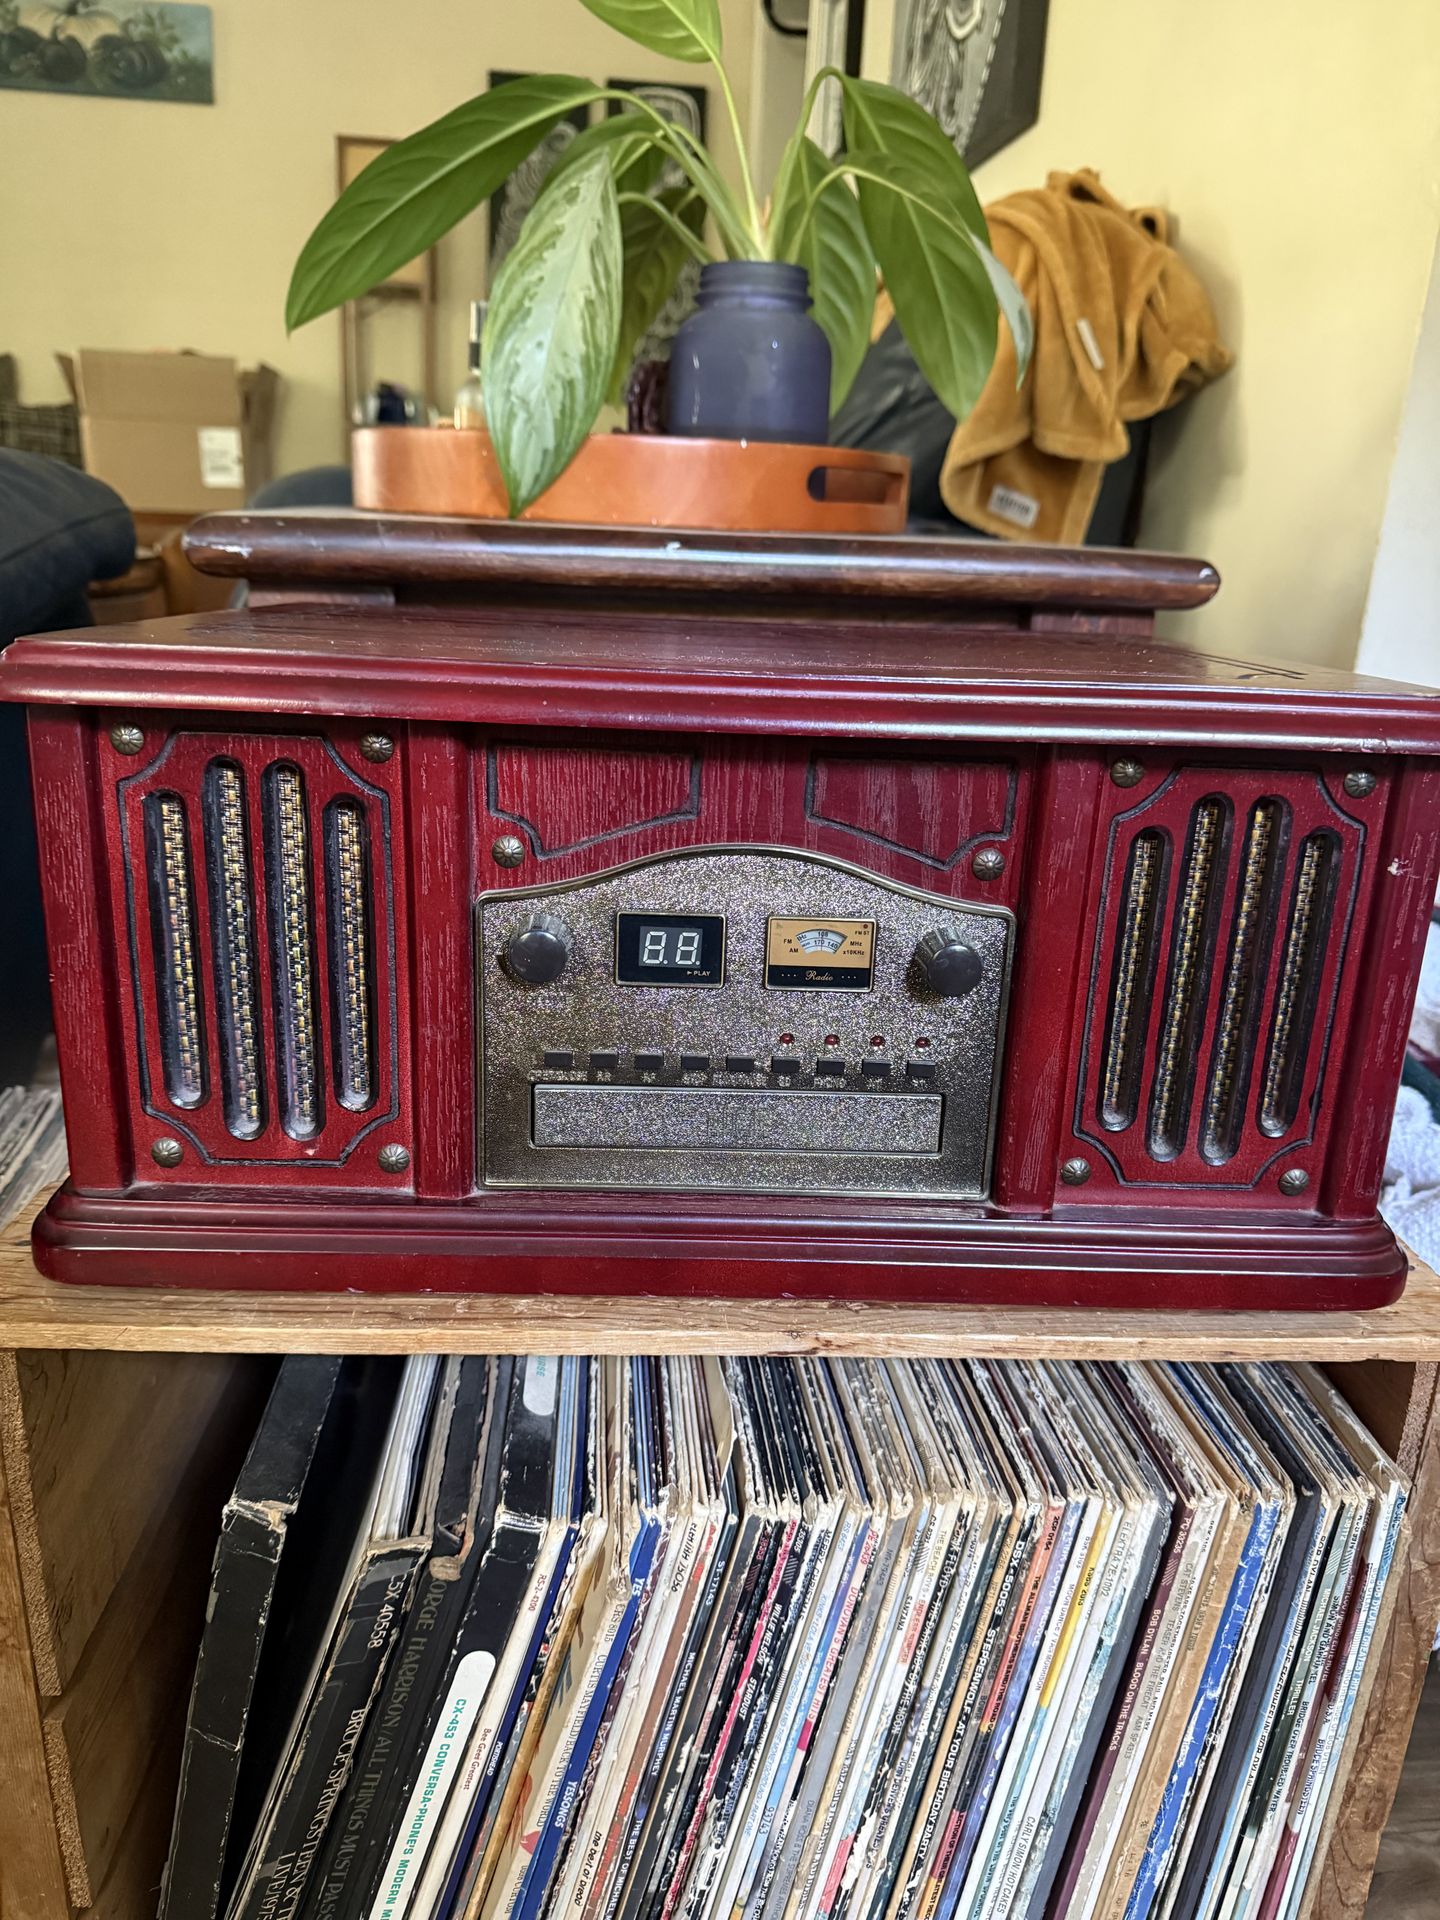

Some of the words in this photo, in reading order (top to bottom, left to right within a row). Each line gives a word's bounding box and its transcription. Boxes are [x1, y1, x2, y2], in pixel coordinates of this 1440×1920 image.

[804, 970, 834, 981] Radio
[867, 1529, 876, 1540] PE
[936, 1529, 947, 1544] THE
[1050, 1515, 1059, 1531] 2CP
[1180, 1517, 1190, 1530] PC
[792, 1528, 807, 1552] 35305
[1043, 1531, 1054, 1551] 0164
[1111, 1521, 1131, 1561] ELEKTRA
[1172, 1530, 1186, 1554] 33235
[928, 1546, 942, 1570] BEACH
[938, 1554, 955, 1588] FLOYD
[1182, 1562, 1193, 1577] CAT
[630, 1575, 645, 1597] YES
[704, 1559, 725, 1606] ST-17143
[921, 1571, 933, 1593] BOYS
[1031, 1575, 1040, 1590] THE
[1099, 1563, 1117, 1597] 7E-1002
[1020, 1591, 1035, 1622] ALLMAN
[1171, 1578, 1188, 1612] STEVENS
[1313, 1587, 1330, 1624] MICHAEL
[1327, 1595, 1341, 1621] SIMON
[766, 1602, 782, 1630] WILLIE
[833, 1586, 858, 1644] DONOVAN'S
[895, 1594, 912, 1631] SANTANA
[927, 1600, 940, 1621] THE
[1149, 1608, 1161, 1627] BOB
[365, 1602, 395, 1651] 40558
[807, 1621, 818, 1640] LOLA
[918, 1621, 933, 1649] DARK
[1160, 1618, 1175, 1645] TEASER
[1321, 1622, 1333, 1639] AND
[755, 1630, 773, 1665] NELSON
[1007, 1622, 1025, 1663] BROTHERS
[1139, 1627, 1155, 1655] DYLAN
[1154, 1646, 1166, 1663] AND
[1302, 1624, 1319, 1662] JACKSON
[586, 1653, 607, 1689] CURTIS
[676, 1651, 695, 1695] MICHAEL
[817, 1647, 838, 1695] GREATEST
[911, 1649, 924, 1672] SIDE
[962, 1627, 996, 1714] STEPPENWOLF
[1149, 1664, 1160, 1679] THE
[907, 1672, 917, 1685] OF
[995, 1664, 1011, 1701] BAND/THE
[1128, 1661, 1143, 1690] BLOOD
[737, 1677, 757, 1720] STARDUST
[900, 1687, 912, 1706] THE
[1124, 1690, 1134, 1704] ON
[1140, 1679, 1155, 1709] FIRECAT
[1285, 1678, 1303, 1716] THRILLER
[442, 1696, 468, 1740] CX-453
[664, 1694, 682, 1730] MARTIN
[808, 1698, 821, 1720] HITS
[891, 1706, 906, 1734] MOON
[988, 1702, 999, 1722] ROAD
[1118, 1702, 1130, 1720] THE
[1294, 1700, 1309, 1728] BRIDGE
[1322, 1703, 1335, 1726] U.S.A.
[332, 1706, 366, 1768] BRUCE
[479, 1727, 491, 1743] Bee
[955, 1720, 966, 1736] AT
[1108, 1719, 1124, 1751] TRACKS
[1287, 1728, 1300, 1749] OVER
[485, 1740, 503, 1776] PORTISHEAD
[650, 1732, 670, 1776] MURPHEY
[944, 1736, 961, 1768] YOUR
[1311, 1738, 1325, 1765] BRUCE
[462, 1760, 479, 1791] Greatest
[895, 1756, 907, 1777] JOHN
[1276, 1750, 1294, 1787] TROUBLED
[346, 1767, 383, 1833] THINGS
[554, 1779, 577, 1828] YESSONGS
[927, 1769, 951, 1823] BIRTHDAY
[1268, 1786, 1282, 1813] WATER
[1297, 1764, 1318, 1816] SPRINGSTEEN
[748, 1804, 759, 1821] PART
[758, 1805, 775, 1835] 93743
[801, 1799, 814, 1822] DIANA
[631, 1819, 642, 1836] THE
[743, 1820, 753, 1835] ONE
[795, 1823, 806, 1843] ROSS
[915, 1824, 933, 1859] PARTY
[1020, 1815, 1035, 1842] CARLY
[330, 1830, 361, 1879] MUST
[623, 1838, 636, 1860] BEST
[789, 1849, 798, 1862] THE
[948, 1840, 955, 1848] OF
[619, 1862, 629, 1873] OF
[941, 1849, 952, 1870] THEIR
[384, 1857, 412, 1906] MODERN
[778, 1862, 794, 1894] SUPREMES
[930, 1870, 945, 1904] GREATEST
[606, 1875, 624, 1914] MICHAEL
